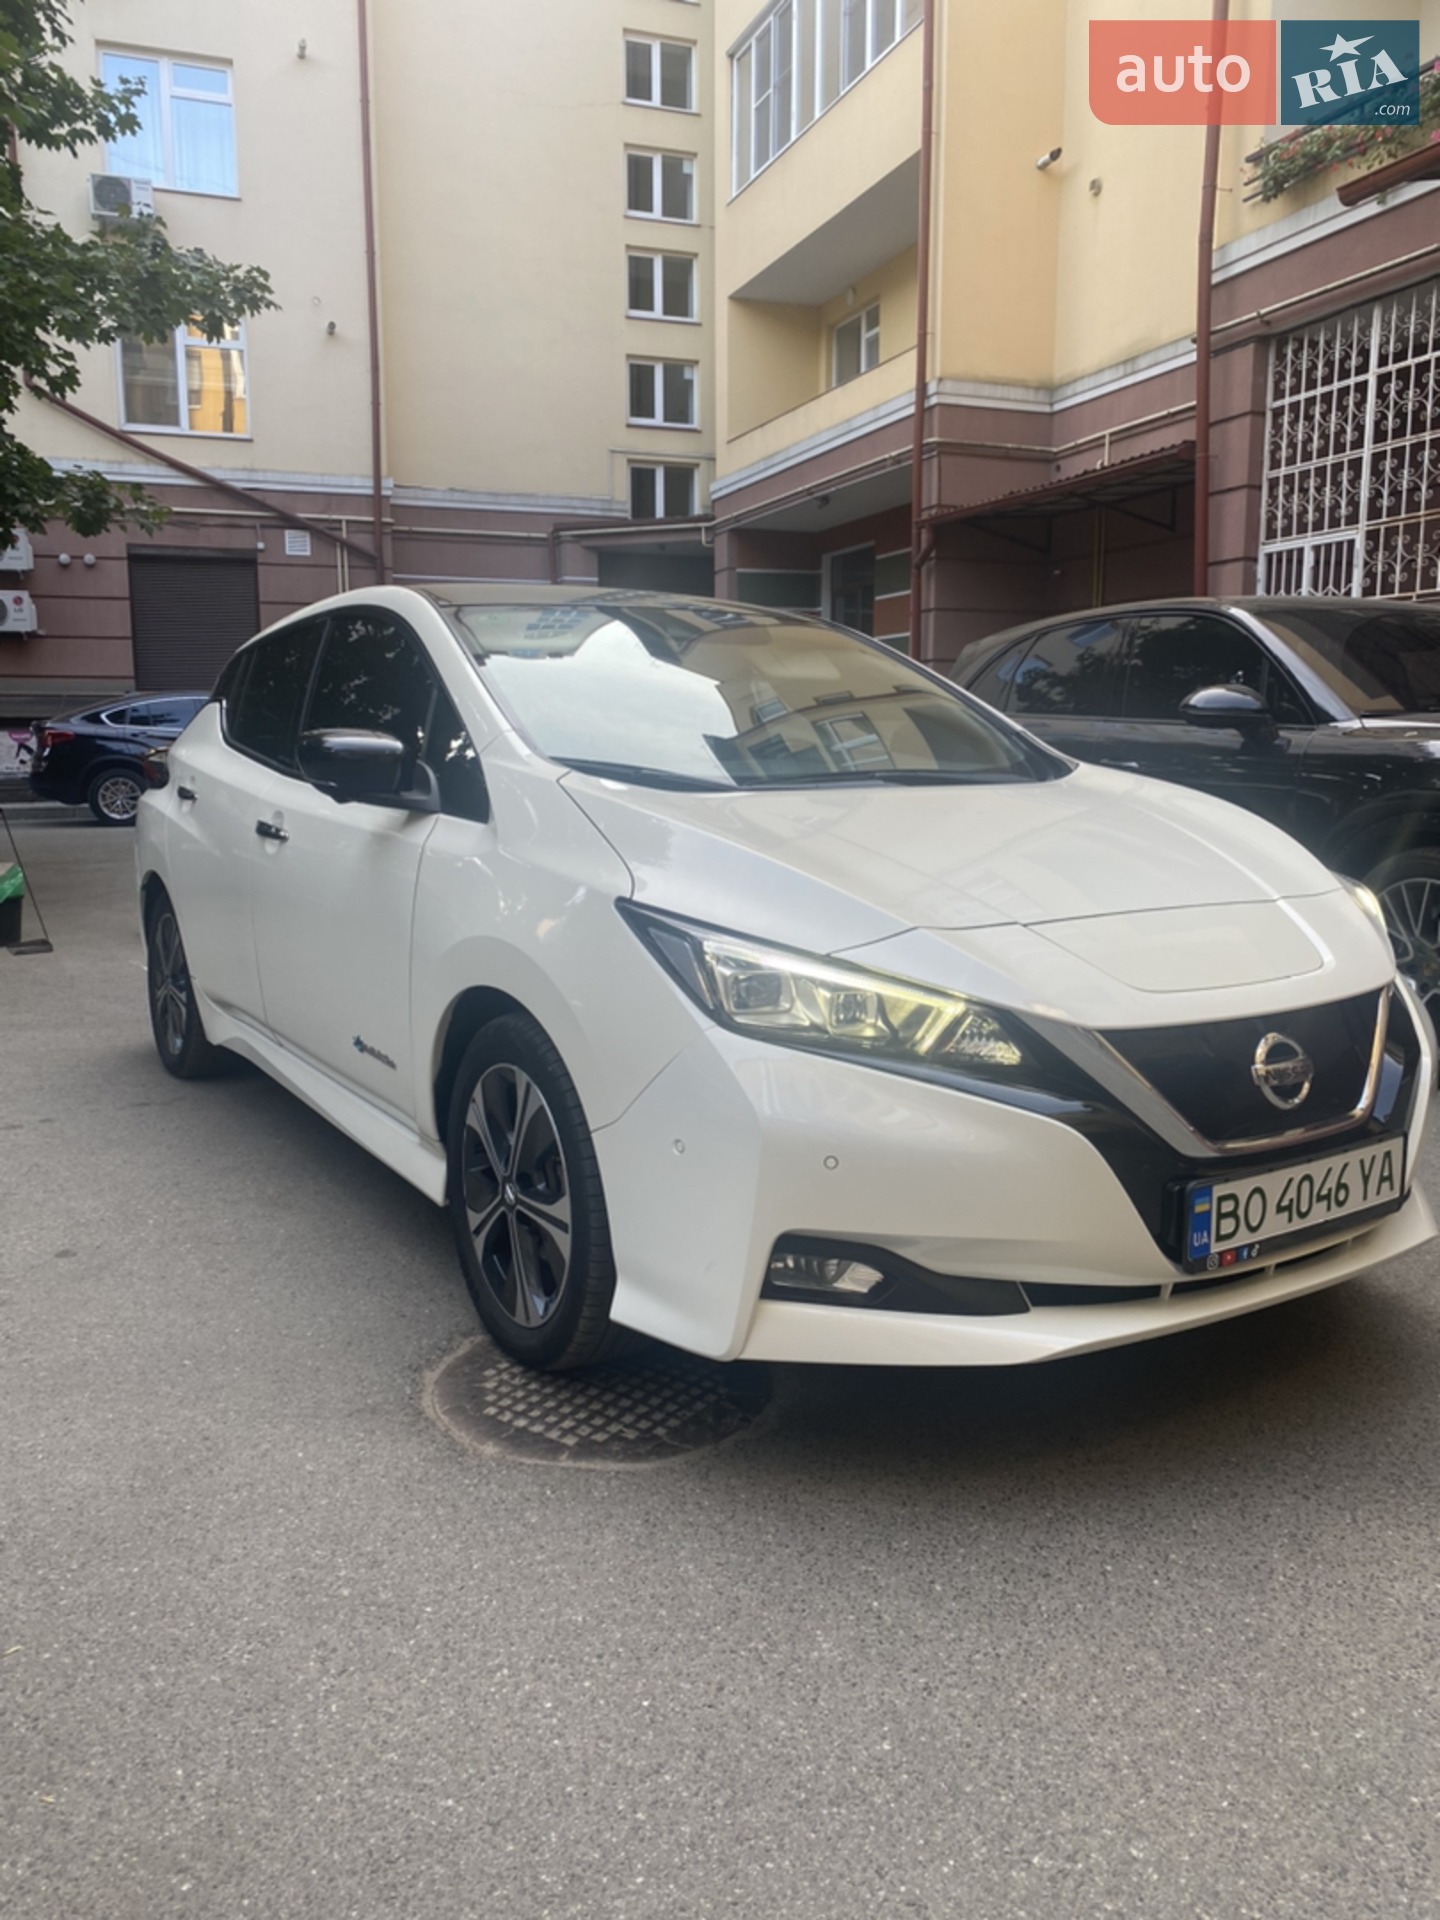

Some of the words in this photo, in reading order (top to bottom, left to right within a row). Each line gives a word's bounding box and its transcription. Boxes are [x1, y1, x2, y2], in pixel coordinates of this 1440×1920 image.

[1214, 1185, 1267, 1243] BO
[1275, 1161, 1350, 1224] 4046
[1359, 1150, 1395, 1201] YA
[1192, 1230, 1209, 1247] UA
